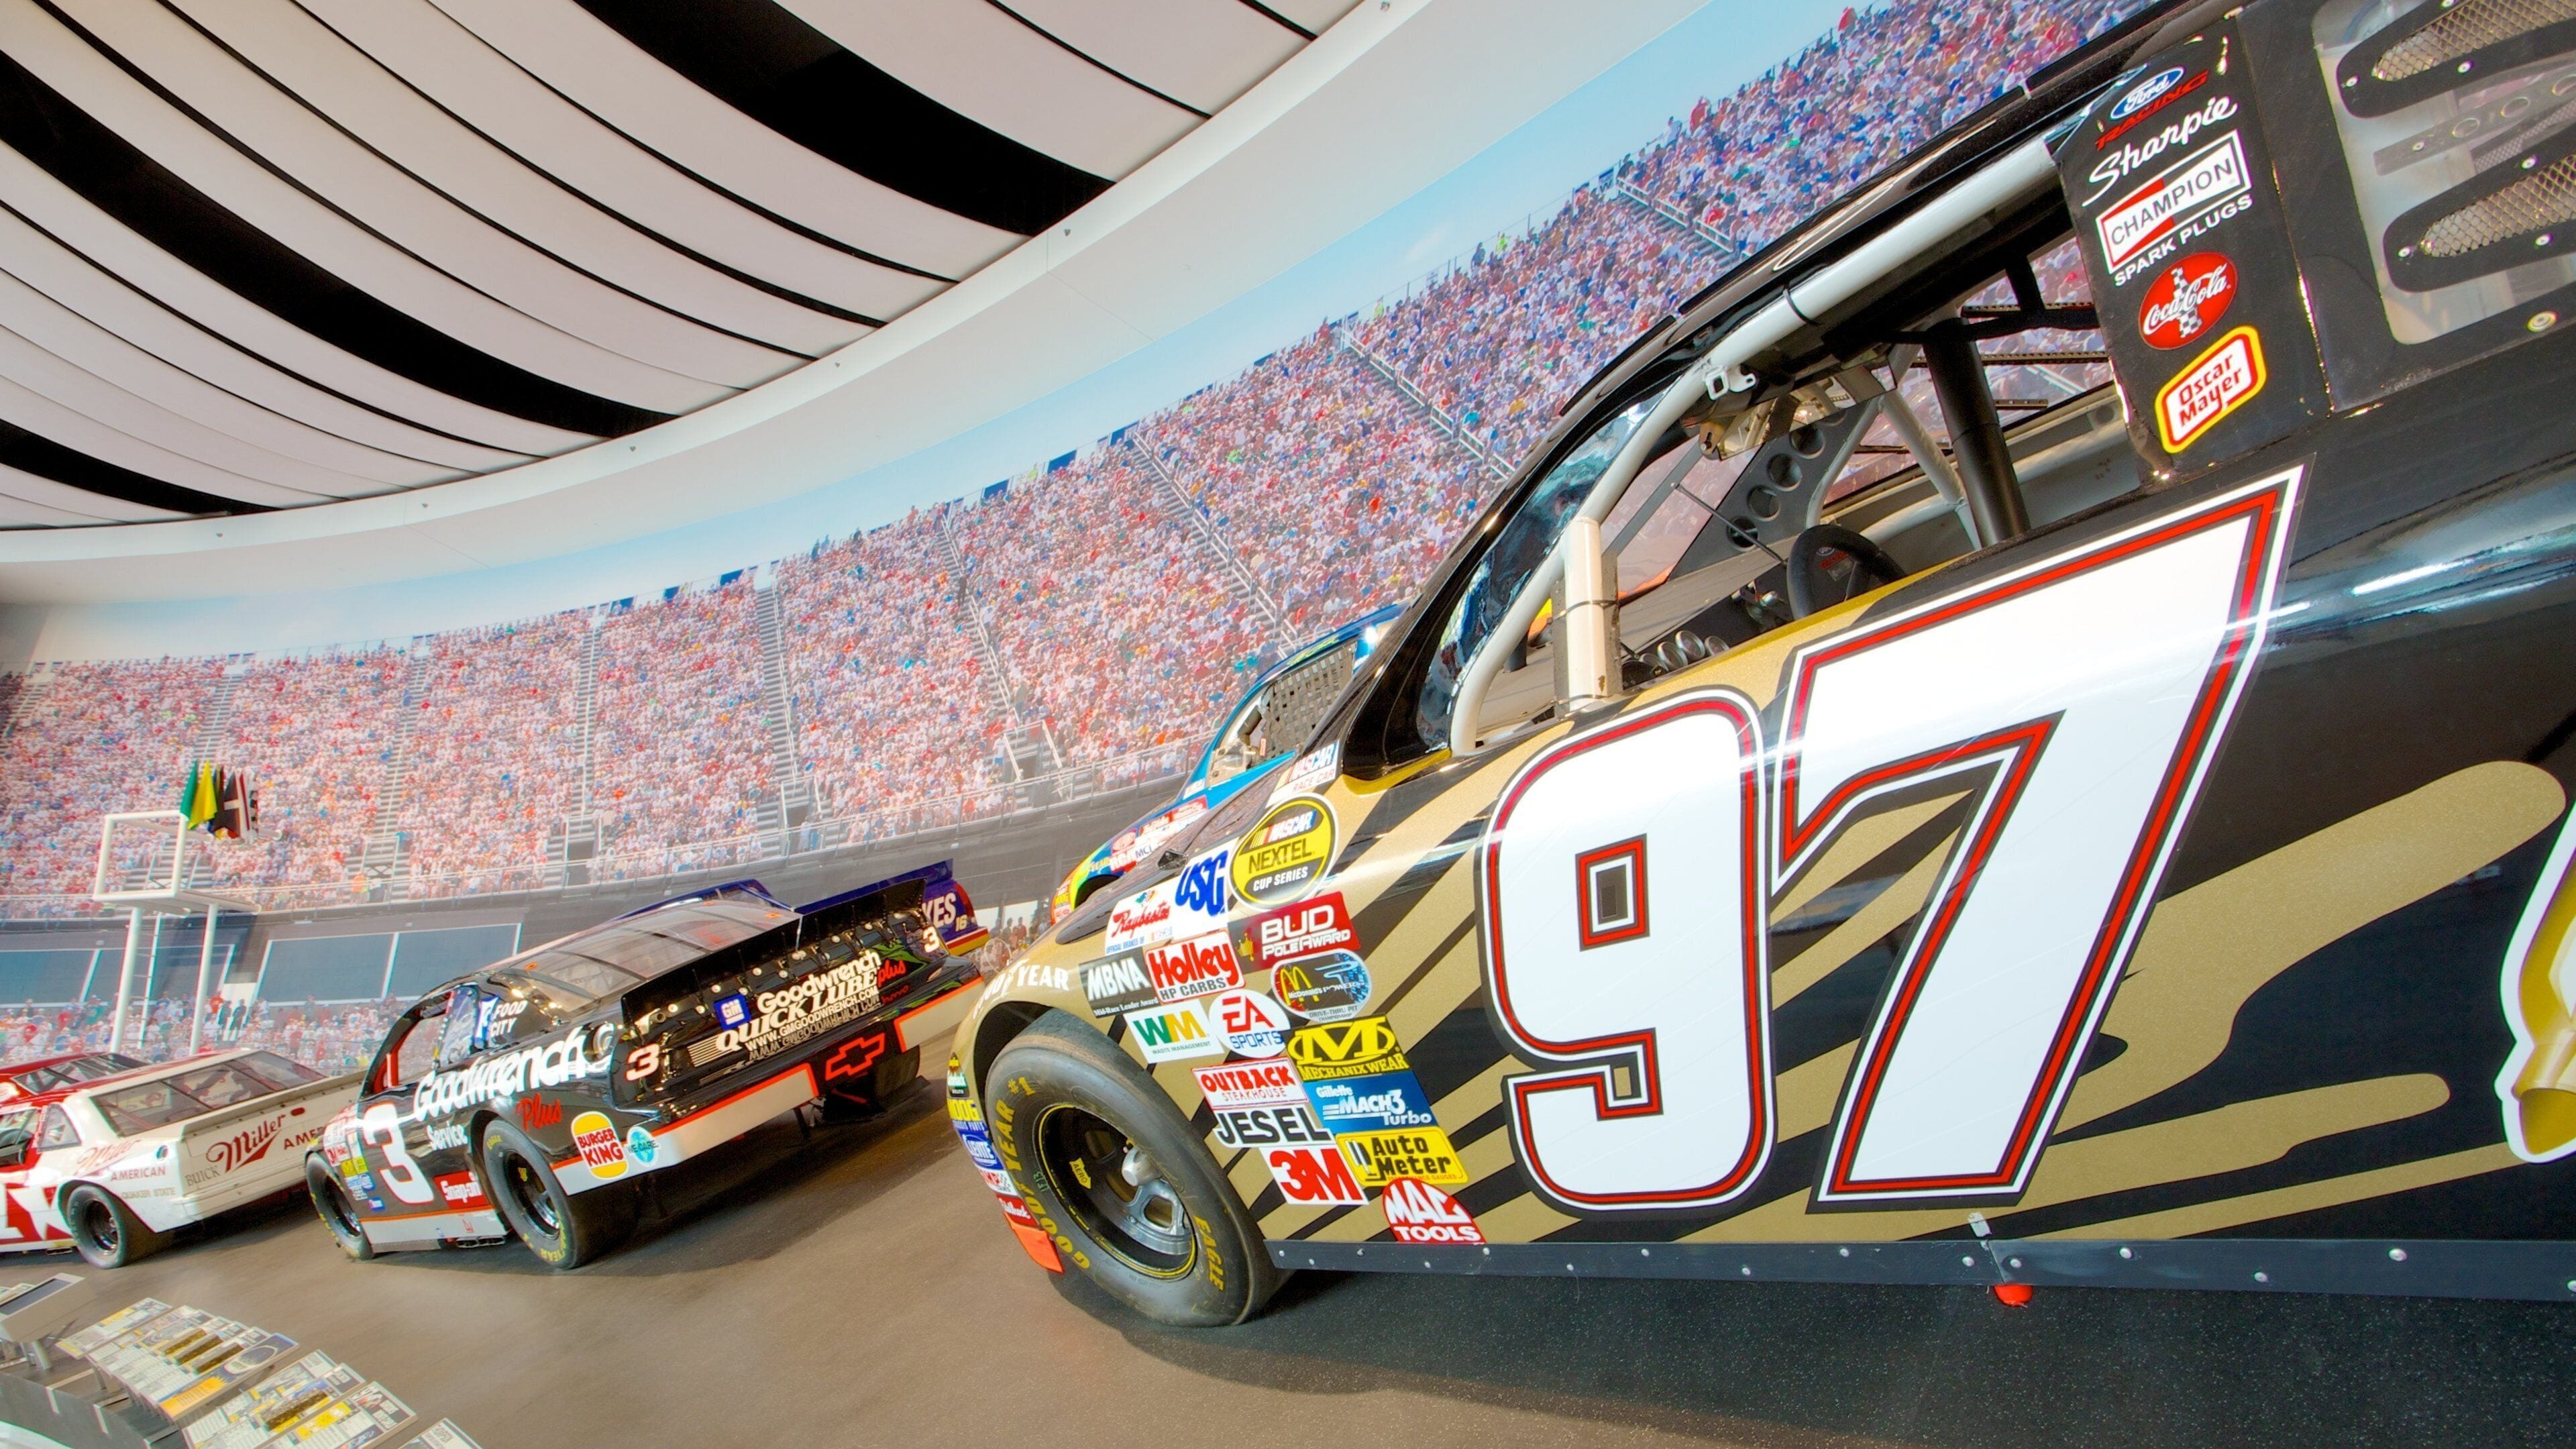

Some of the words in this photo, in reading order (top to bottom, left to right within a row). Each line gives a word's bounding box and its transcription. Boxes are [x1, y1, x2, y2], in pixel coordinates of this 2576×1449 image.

[2124, 74, 2170, 113] Ford
[2095, 69, 2209, 151] RACING
[2082, 95, 2239, 207] Sharpie
[2111, 158, 2233, 246] CHAMPION
[2114, 237, 2177, 286] SPARK
[2180, 193, 2253, 245] PLUGS
[2178, 353, 2234, 405] Oscar
[2179, 368, 2243, 428] Mayer
[1292, 774, 1314, 792] RACE
[1316, 768, 1335, 784] CAR
[1267, 810, 1316, 845] NASCAR
[1479, 467, 2302, 1211] 97
[1248, 839, 1312, 874] NEXTEL
[1253, 873, 1272, 892] CUP
[1273, 866, 1308, 885] SERIES
[955, 914, 968, 932] 16
[1261, 905, 1334, 945] BUD
[922, 926, 941, 954] 3
[1087, 956, 1152, 1002] MBNA
[1148, 942, 1240, 988] Holley
[757, 950, 881, 1014] Goodwrench
[877, 959, 906, 987] plus
[1160, 987, 1177, 1001] HP
[1179, 977, 1227, 996] CARBS
[493, 1000, 528, 1021] FOOD
[715, 998, 809, 1052] QUICK
[811, 968, 879, 1013] LUBE
[720, 998, 743, 1018] GM
[745, 985, 880, 1051] WWW.GMGOODWRENCH.COM
[1093, 1004, 1120, 1017] Mid-Race
[1121, 1001, 1140, 1012] Leader
[1140, 996, 1160, 1008] Award
[1222, 995, 1275, 1034] EA
[490, 1017, 518, 1037] CITY
[1132, 1010, 1207, 1046] WM
[1229, 1030, 1285, 1050] SPORTS
[625, 1042, 659, 1081] 3
[1152, 1046, 1171, 1055] WASTE
[1171, 1040, 1211, 1052] MANAGEMENT
[413, 1024, 587, 1122] Goodwrench
[1008, 1076, 1036, 1096] #1
[1200, 1065, 1296, 1092] OUTBACK
[1222, 1087, 1287, 1102] STEAKHOUSE
[1316, 1084, 1354, 1099] Gillette
[515, 1092, 562, 1132] Plus
[1217, 1108, 1332, 1144] JESEL
[1381, 1110, 1433, 1126] Turbo
[205, 1113, 286, 1173] Miller
[426, 1122, 469, 1151] Service
[577, 1128, 616, 1148] BURGER
[627, 1144, 639, 1154] WE
[638, 1140, 659, 1151] CARE
[1371, 1134, 1430, 1157] Auto
[362, 1102, 435, 1205] 3
[582, 1142, 624, 1167] KING
[1375, 1155, 1452, 1179] Meter
[111, 1165, 166, 1182] AMERICAN
[184, 1165, 219, 1187] BUICK
[1073, 1163, 1087, 1183] AERO
[1269, 1148, 1363, 1201] 3M
[153, 1186, 176, 1198] STATE
[1385, 1180, 1472, 1224] MAC
[1393, 1226, 1481, 1241] TOOLS
[1193, 1215, 1225, 1291] EAGLE
